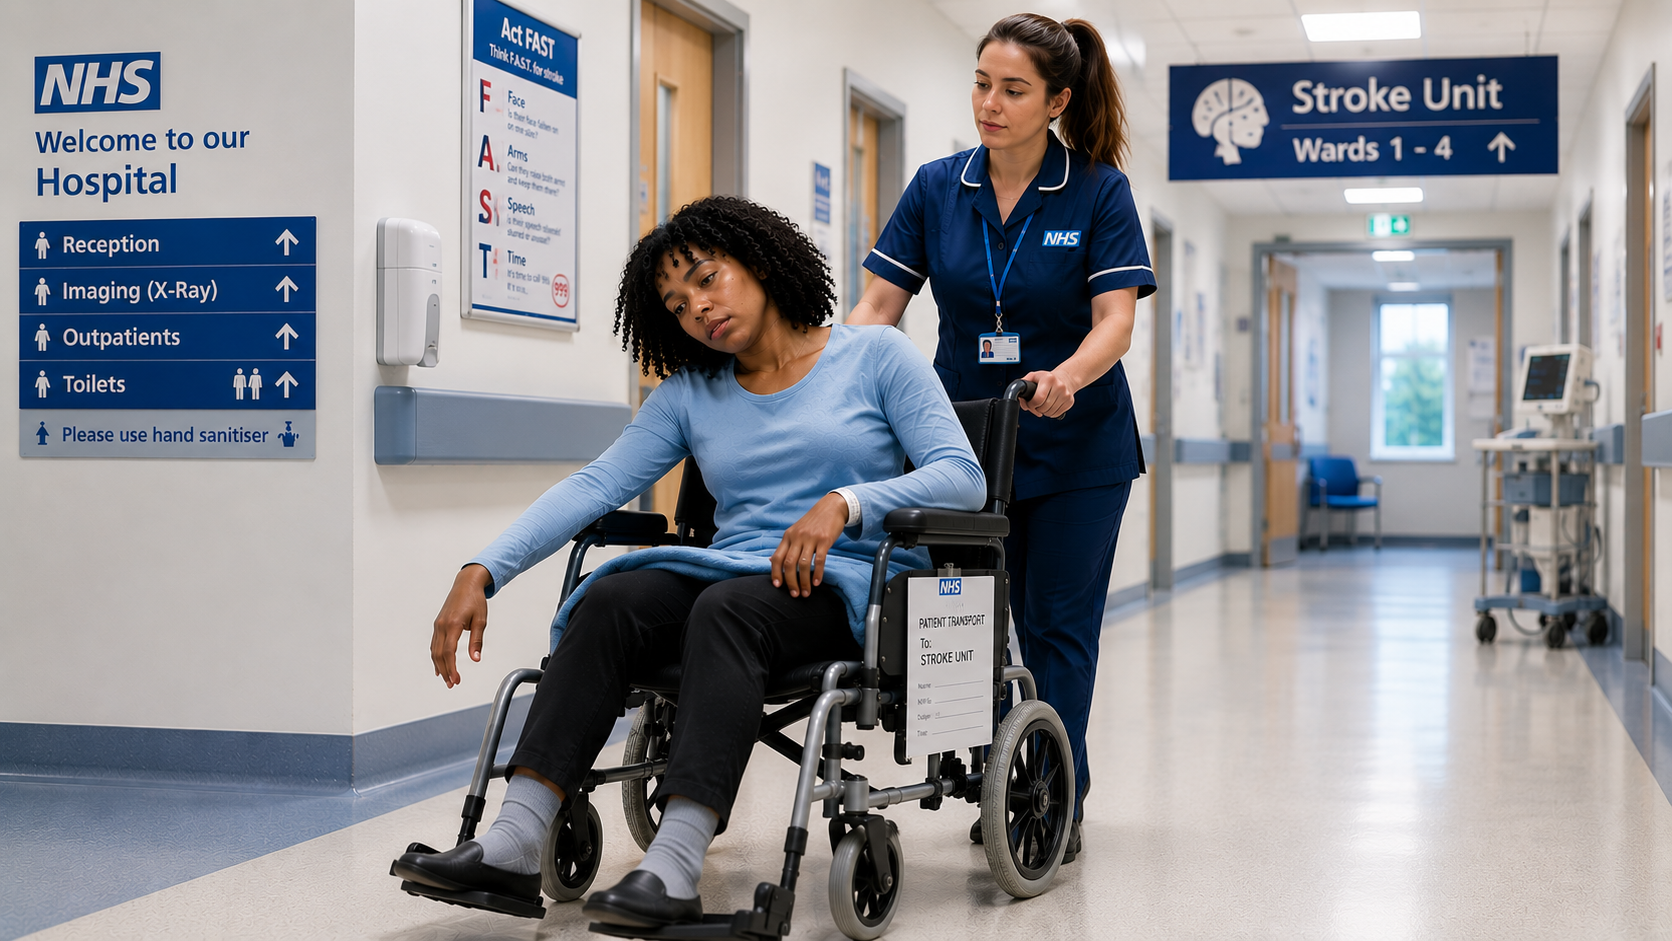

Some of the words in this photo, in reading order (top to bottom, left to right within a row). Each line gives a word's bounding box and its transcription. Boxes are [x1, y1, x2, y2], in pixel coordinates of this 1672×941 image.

[501, 17, 523, 46] Act
[525, 28, 555, 59] FAST
[489, 43, 509, 63] Think
[533, 61, 543, 76] for
[40, 59, 154, 105] NHS
[507, 90, 525, 109] Face
[1292, 76, 1411, 114] Stroke
[1423, 74, 1503, 111] Unit
[35, 129, 156, 153] Welcome
[165, 128, 194, 150] to
[203, 130, 250, 149] our
[1292, 136, 1380, 163] Wards
[1390, 136, 1402, 161] 1
[1434, 135, 1453, 160] 4
[507, 144, 528, 162] Arms
[37, 163, 177, 203] Hospital
[507, 197, 535, 216] Speech
[63, 234, 160, 257] Reception
[1044, 232, 1079, 245] NHS
[507, 249, 526, 267] Time
[63, 281, 140, 304] Imaging
[147, 280, 218, 303] (X-Ray)
[554, 282, 568, 298] 999
[63, 327, 181, 350] Outpatients
[63, 374, 126, 393] Toilets
[62, 427, 114, 443] Please
[120, 430, 147, 443] use
[152, 427, 194, 443] hand
[199, 427, 269, 443] sanitiser
[940, 580, 960, 594] NHS
[919, 616, 946, 629] PATIENT
[920, 638, 932, 648] To:
[920, 651, 953, 666] STROKE
[955, 649, 974, 662] UNIT
